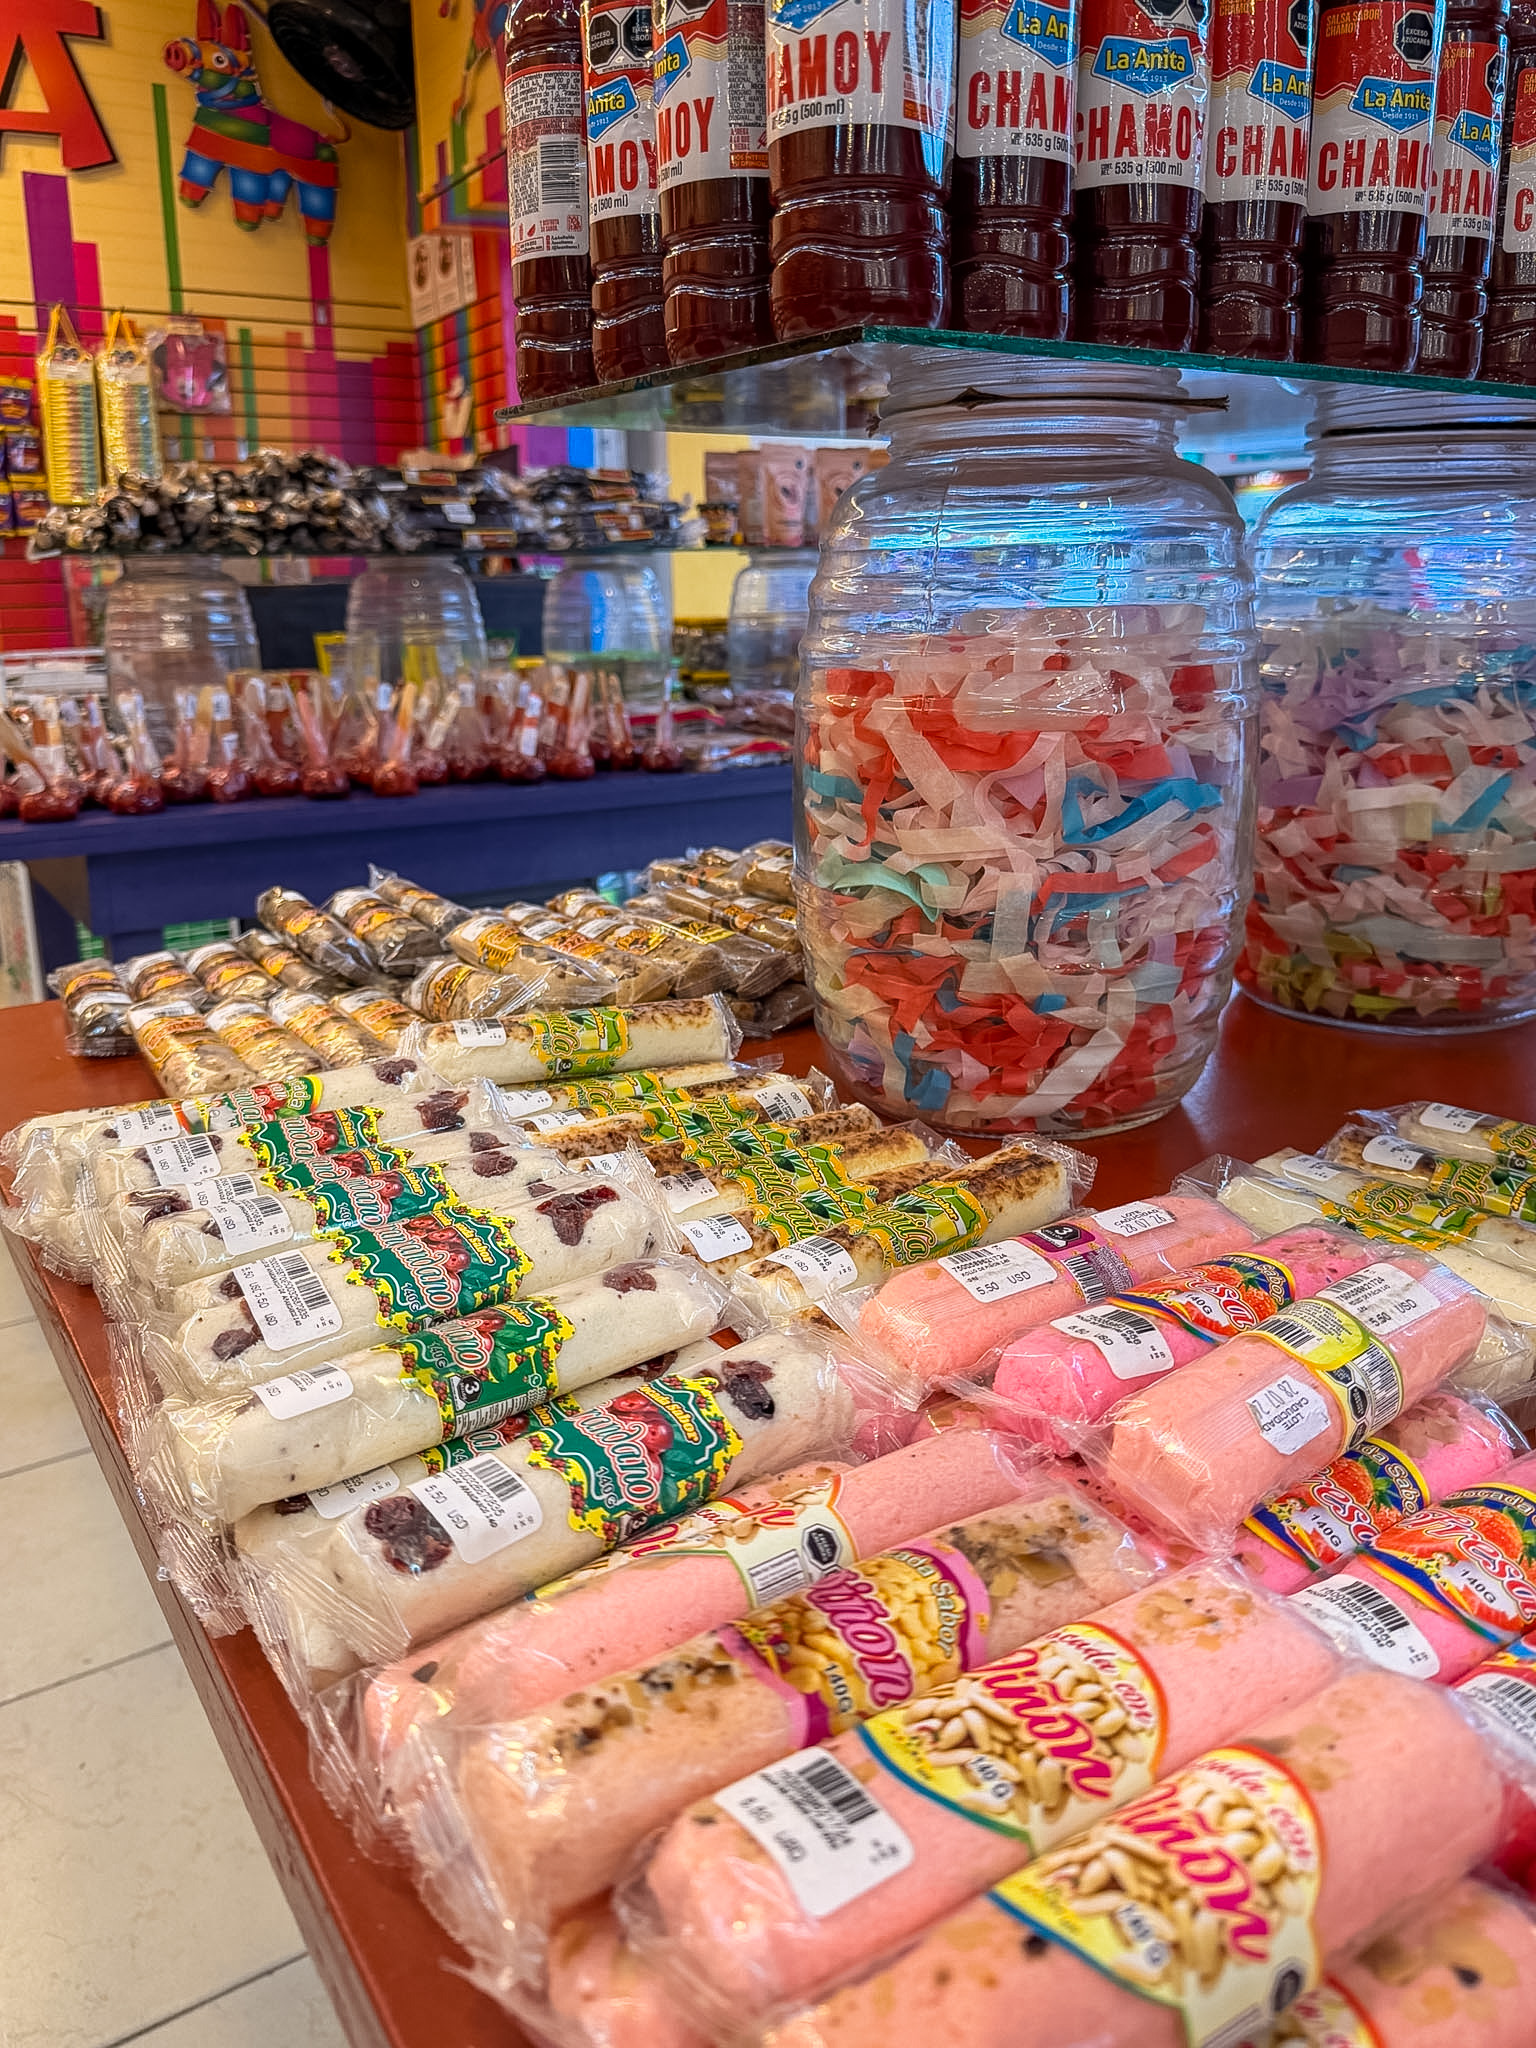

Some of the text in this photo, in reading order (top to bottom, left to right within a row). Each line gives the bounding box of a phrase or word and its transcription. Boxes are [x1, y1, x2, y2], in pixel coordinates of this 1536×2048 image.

[1018, 11, 1040, 34] La
[1406, 29, 1428, 38] EXCESO
[1106, 46, 1186, 72] La Anita
[1262, 72, 1283, 94] La
[1364, 90, 1386, 108] La
[1115, 163, 1132, 175] 535
[976, 1270, 1031, 1295] 5.50 USD
[1394, 1299, 1417, 1314] USD
[1276, 1380, 1300, 1398] 28
[1261, 1396, 1310, 1432] CADUCIDAD
[1281, 1412, 1305, 1431] LOTE
[596, 1466, 618, 1508] 140G
[1310, 1512, 1342, 1548] 140G
[1459, 1567, 1497, 1604] 140G
[931, 1581, 965, 1659] Sabor
[824, 1661, 853, 1713] 140G
